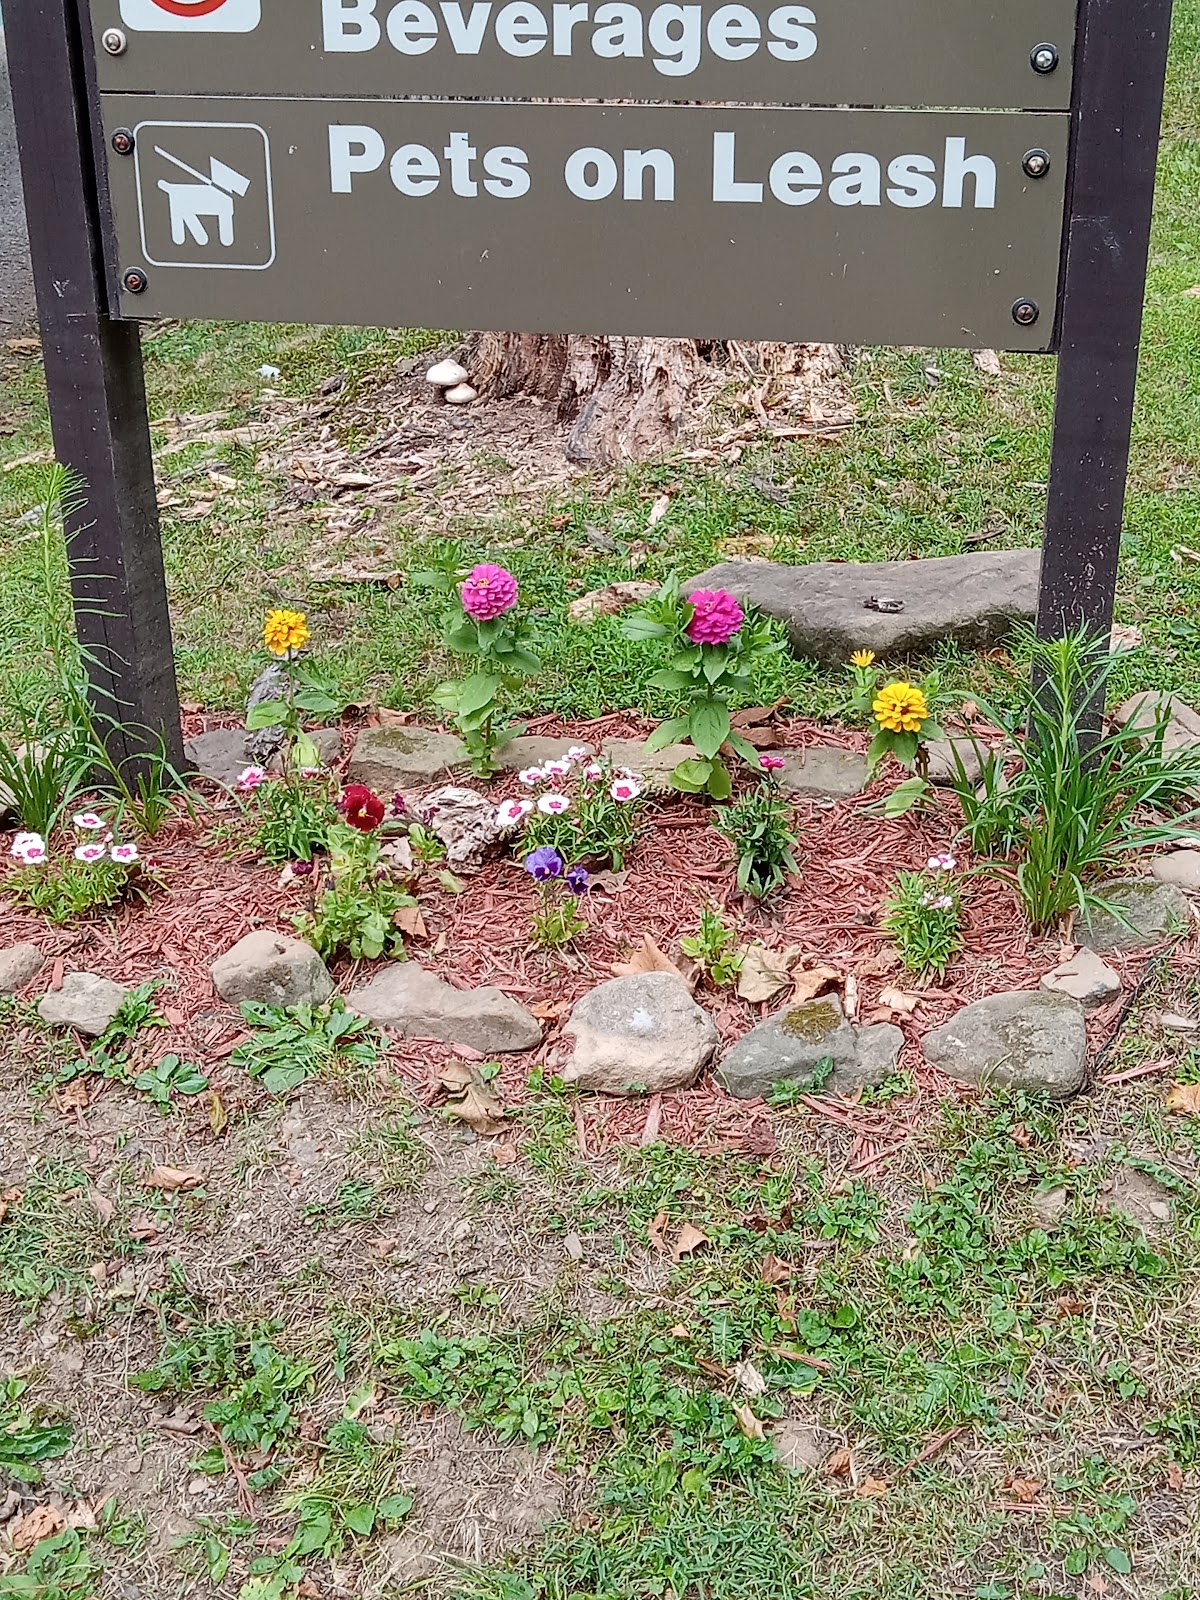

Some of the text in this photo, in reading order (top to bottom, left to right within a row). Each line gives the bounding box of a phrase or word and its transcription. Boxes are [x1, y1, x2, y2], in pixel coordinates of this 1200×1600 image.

[321, 0, 818, 77] Beverages
[328, 124, 997, 209] Pets on Leash
